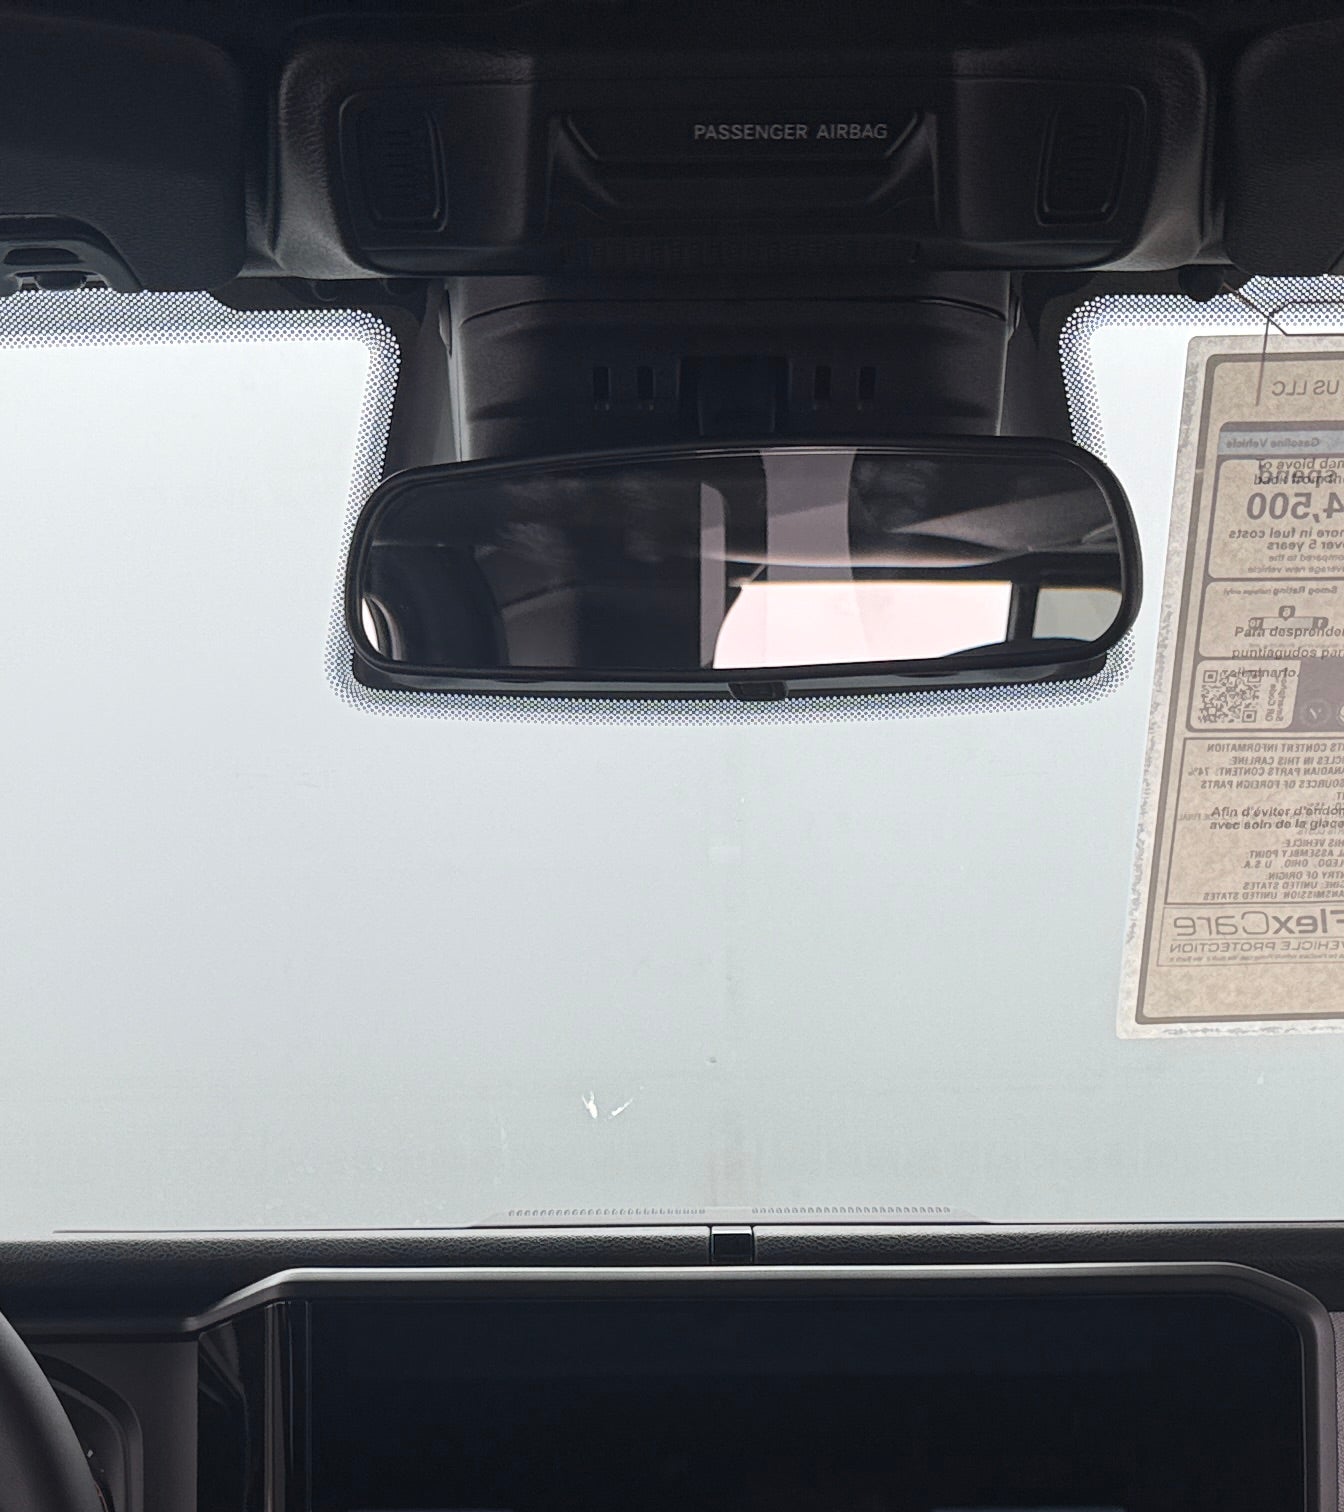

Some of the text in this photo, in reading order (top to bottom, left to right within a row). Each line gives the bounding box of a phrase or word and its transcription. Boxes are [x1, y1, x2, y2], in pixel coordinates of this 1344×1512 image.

[694, 123, 889, 140] PASSENGER AIRBAG
[1277, 457, 1315, 471] avoid
